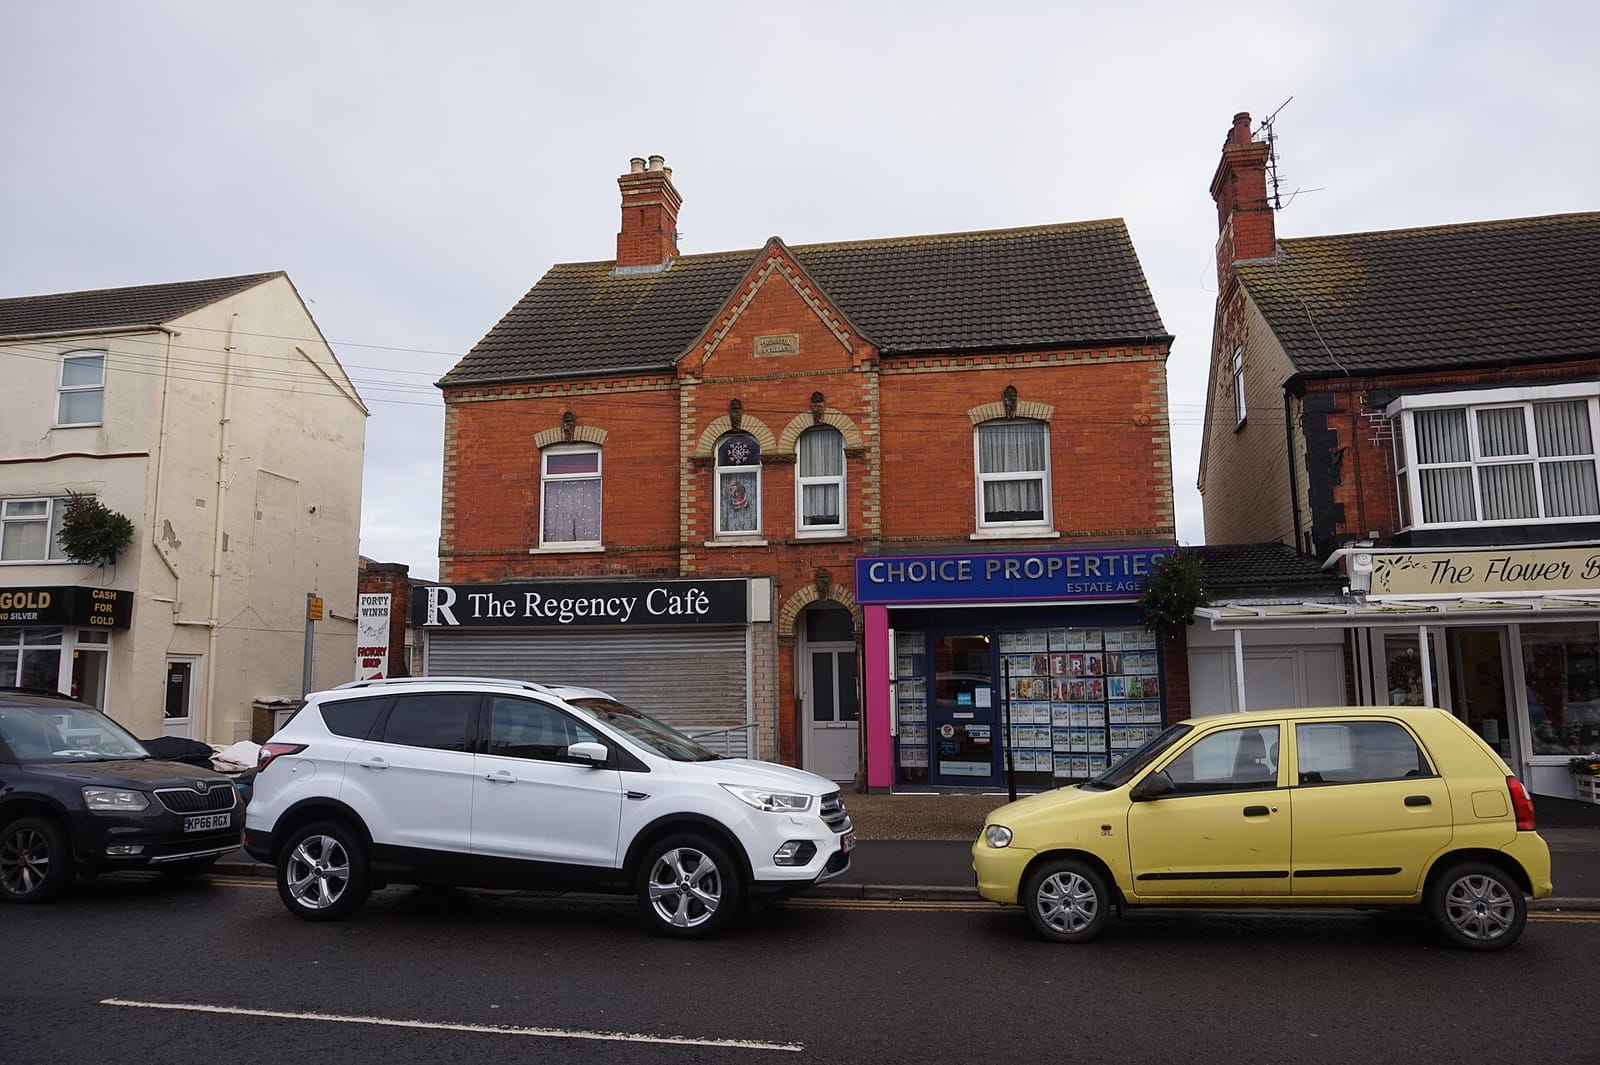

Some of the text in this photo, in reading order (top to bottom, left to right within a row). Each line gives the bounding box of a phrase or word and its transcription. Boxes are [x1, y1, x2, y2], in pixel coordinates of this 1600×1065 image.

[869, 560, 973, 583] CHOICE
[1430, 558, 1475, 584] The
[1484, 556, 1574, 583] Flower
[1067, 582, 1113, 593] ESTATE
[0, 592, 51, 609] GOLD
[92, 590, 117, 600] CASH
[361, 596, 389, 606] FORTY
[423, 586, 461, 626] R
[467, 588, 710, 623] The Regency Café
[94, 603, 112, 613] FOR
[361, 607, 389, 617] WINKS
[10, 612, 38, 620] SILVER
[90, 616, 114, 626] GOLD
[357, 646, 387, 657] FACTORY
[188, 815, 228, 830] KP66 RGX
